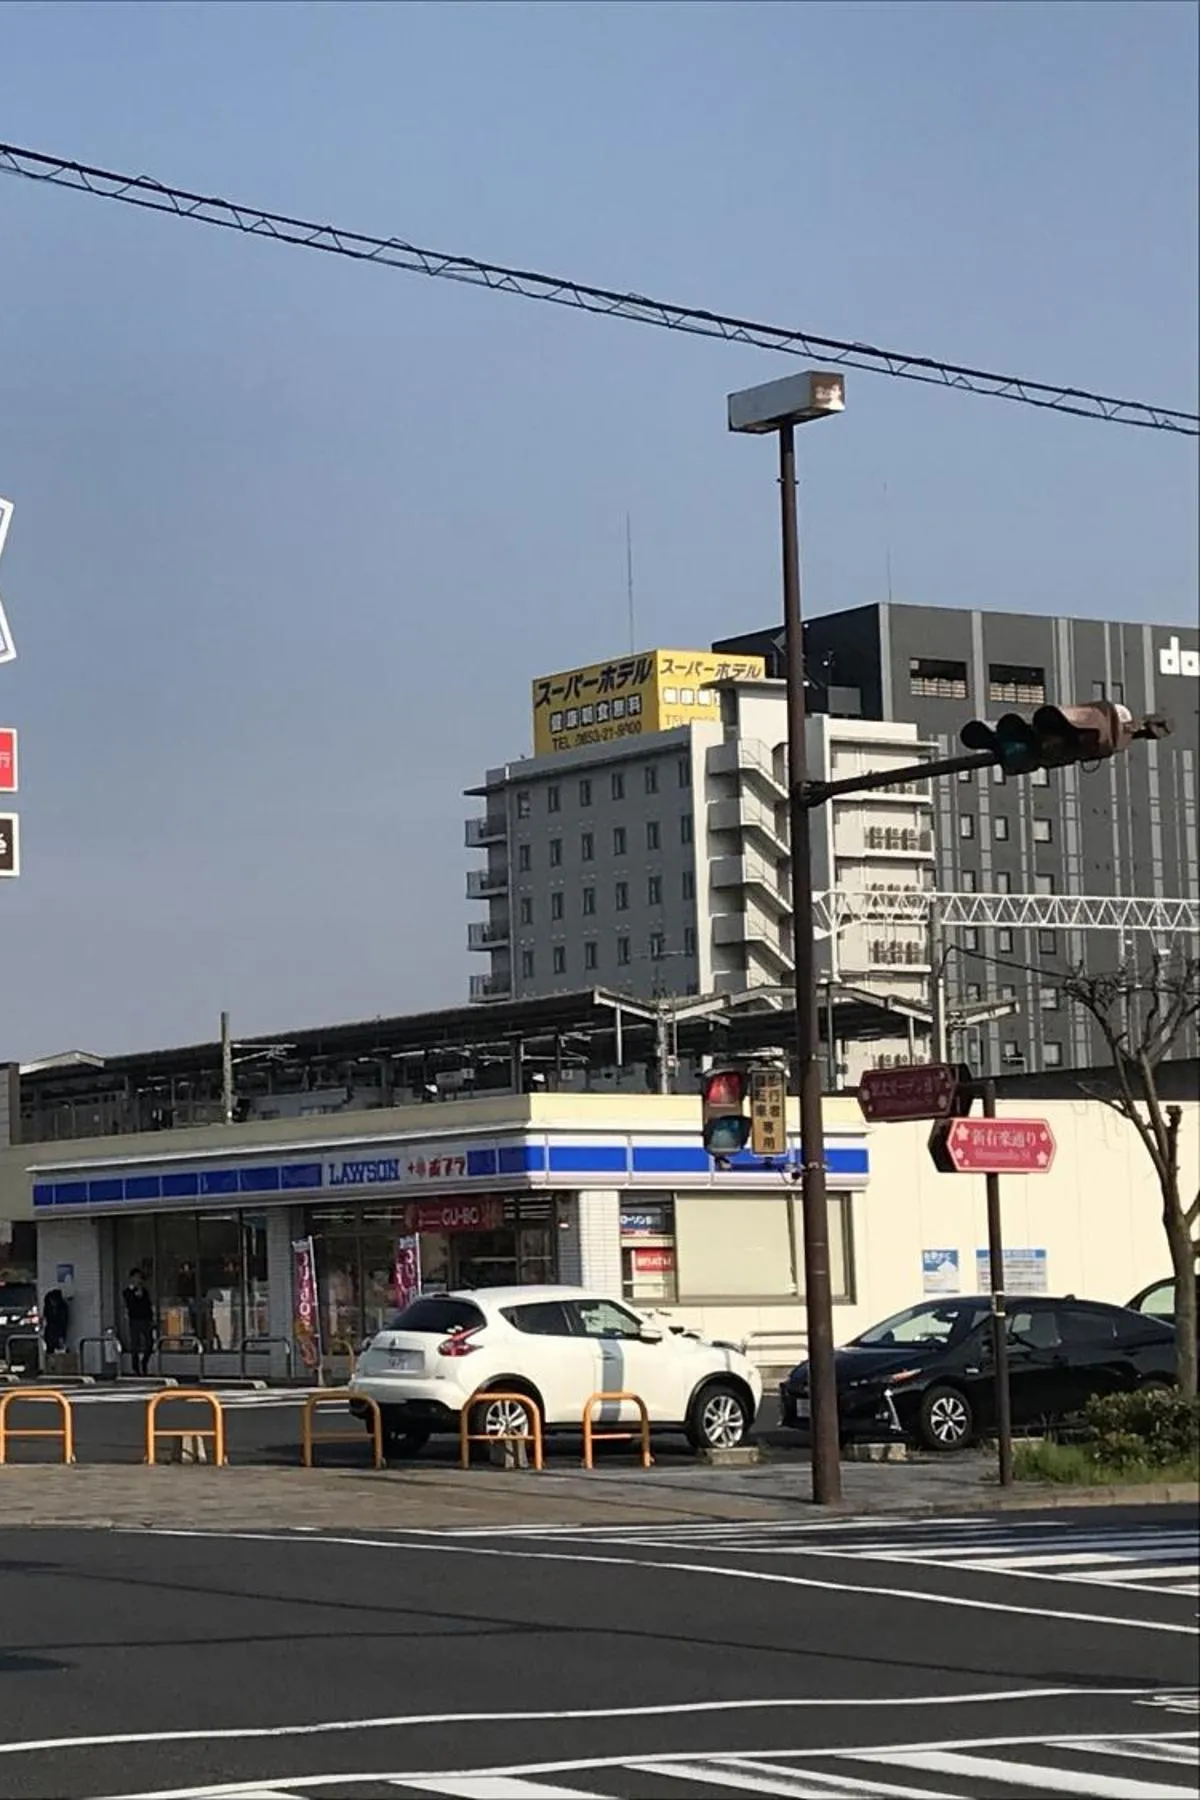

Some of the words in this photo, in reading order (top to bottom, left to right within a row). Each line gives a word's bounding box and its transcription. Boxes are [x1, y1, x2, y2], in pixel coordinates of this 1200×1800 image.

[661, 658, 763, 679] スーパーホテル
[535, 657, 654, 708] スーパーホテル
[329, 1158, 399, 1185] LAWSON
